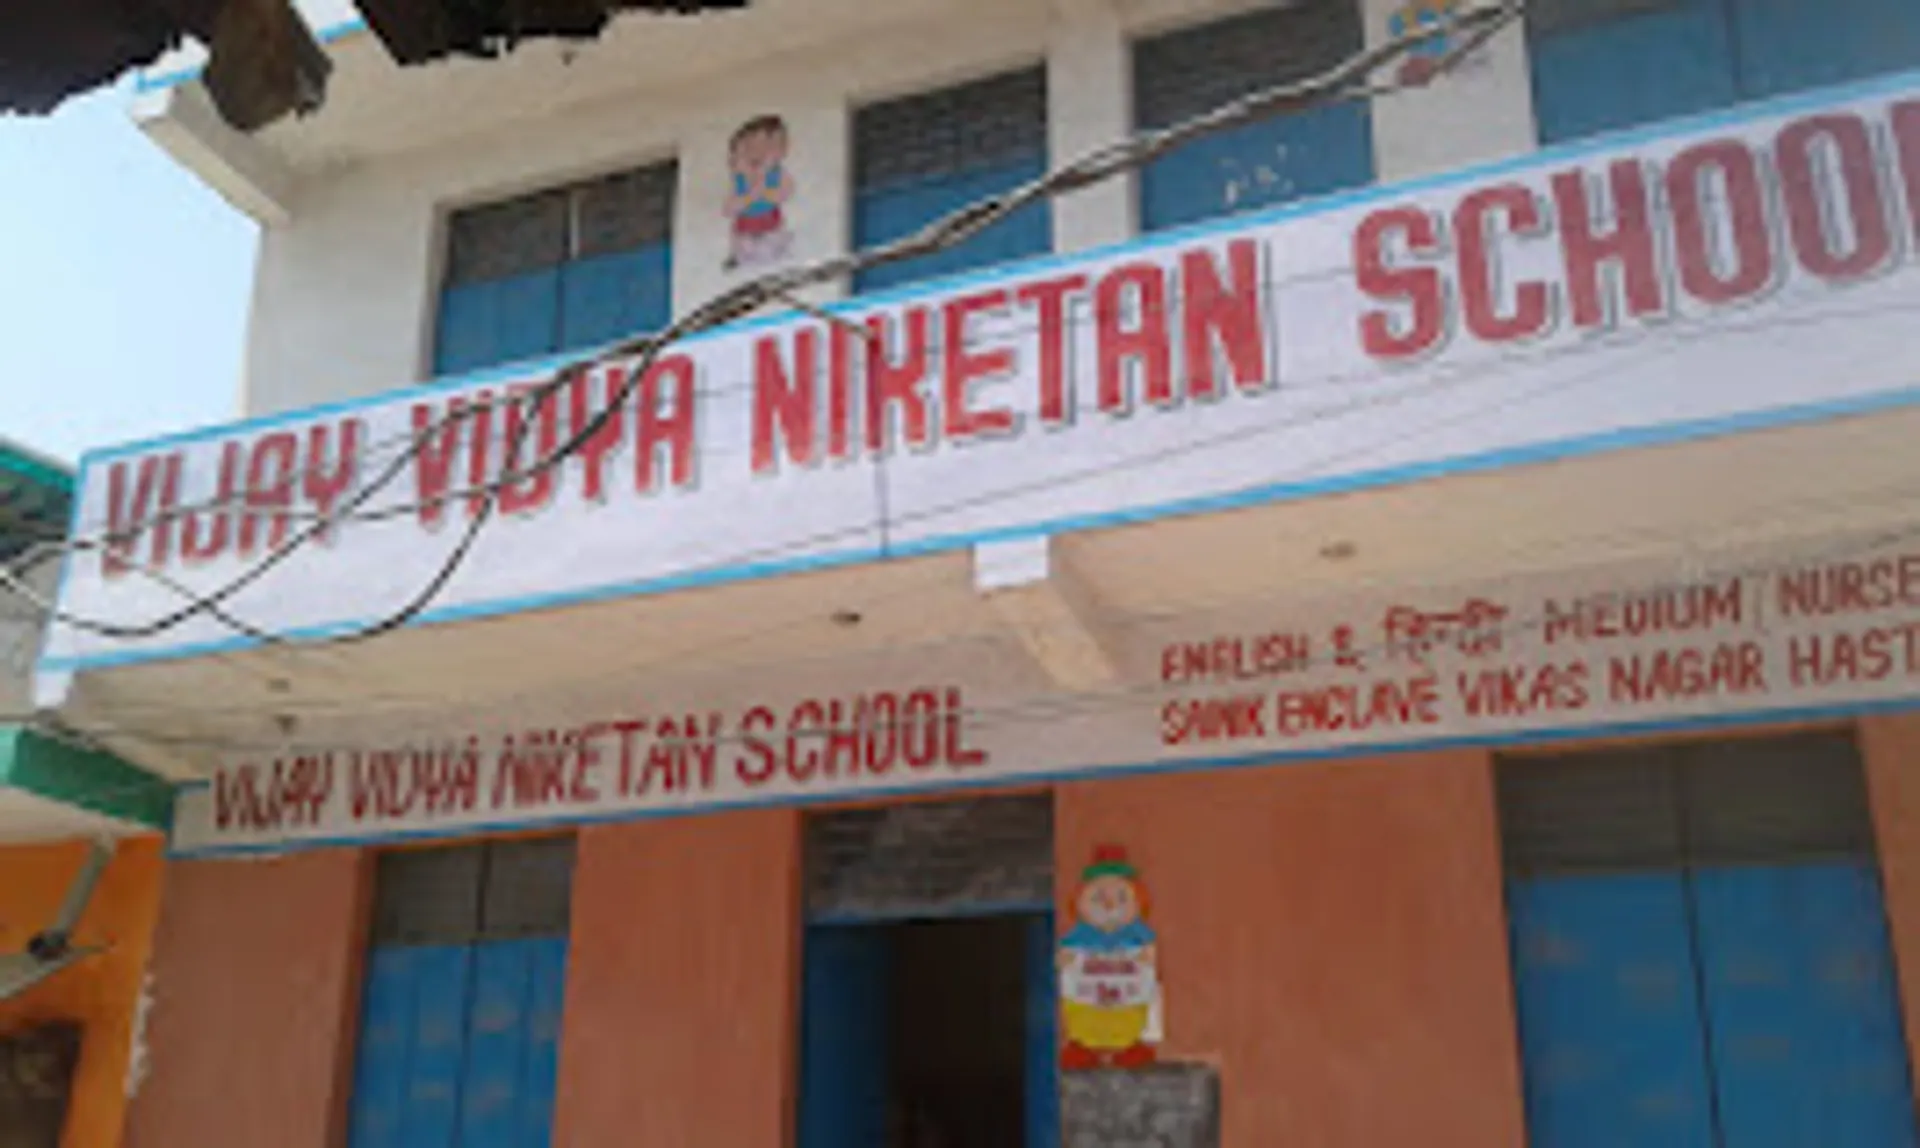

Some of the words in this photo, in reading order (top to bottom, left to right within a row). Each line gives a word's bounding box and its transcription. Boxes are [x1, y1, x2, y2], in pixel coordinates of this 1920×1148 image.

[101, 418, 358, 577] VIJAY
[411, 353, 695, 523] VIDYA
[751, 239, 1266, 474] NIKETAN
[1544, 577, 1741, 644] MEDIUM
[1278, 675, 1439, 736] ENCLAVE
[1457, 659, 1589, 718] VIKAS
[1609, 641, 1768, 703] NAGAR
[215, 752, 333, 829] VIJAY
[350, 734, 478, 819] VIDYA
[491, 712, 720, 808] NIKETAN
[736, 687, 988, 786] SCHOOL
